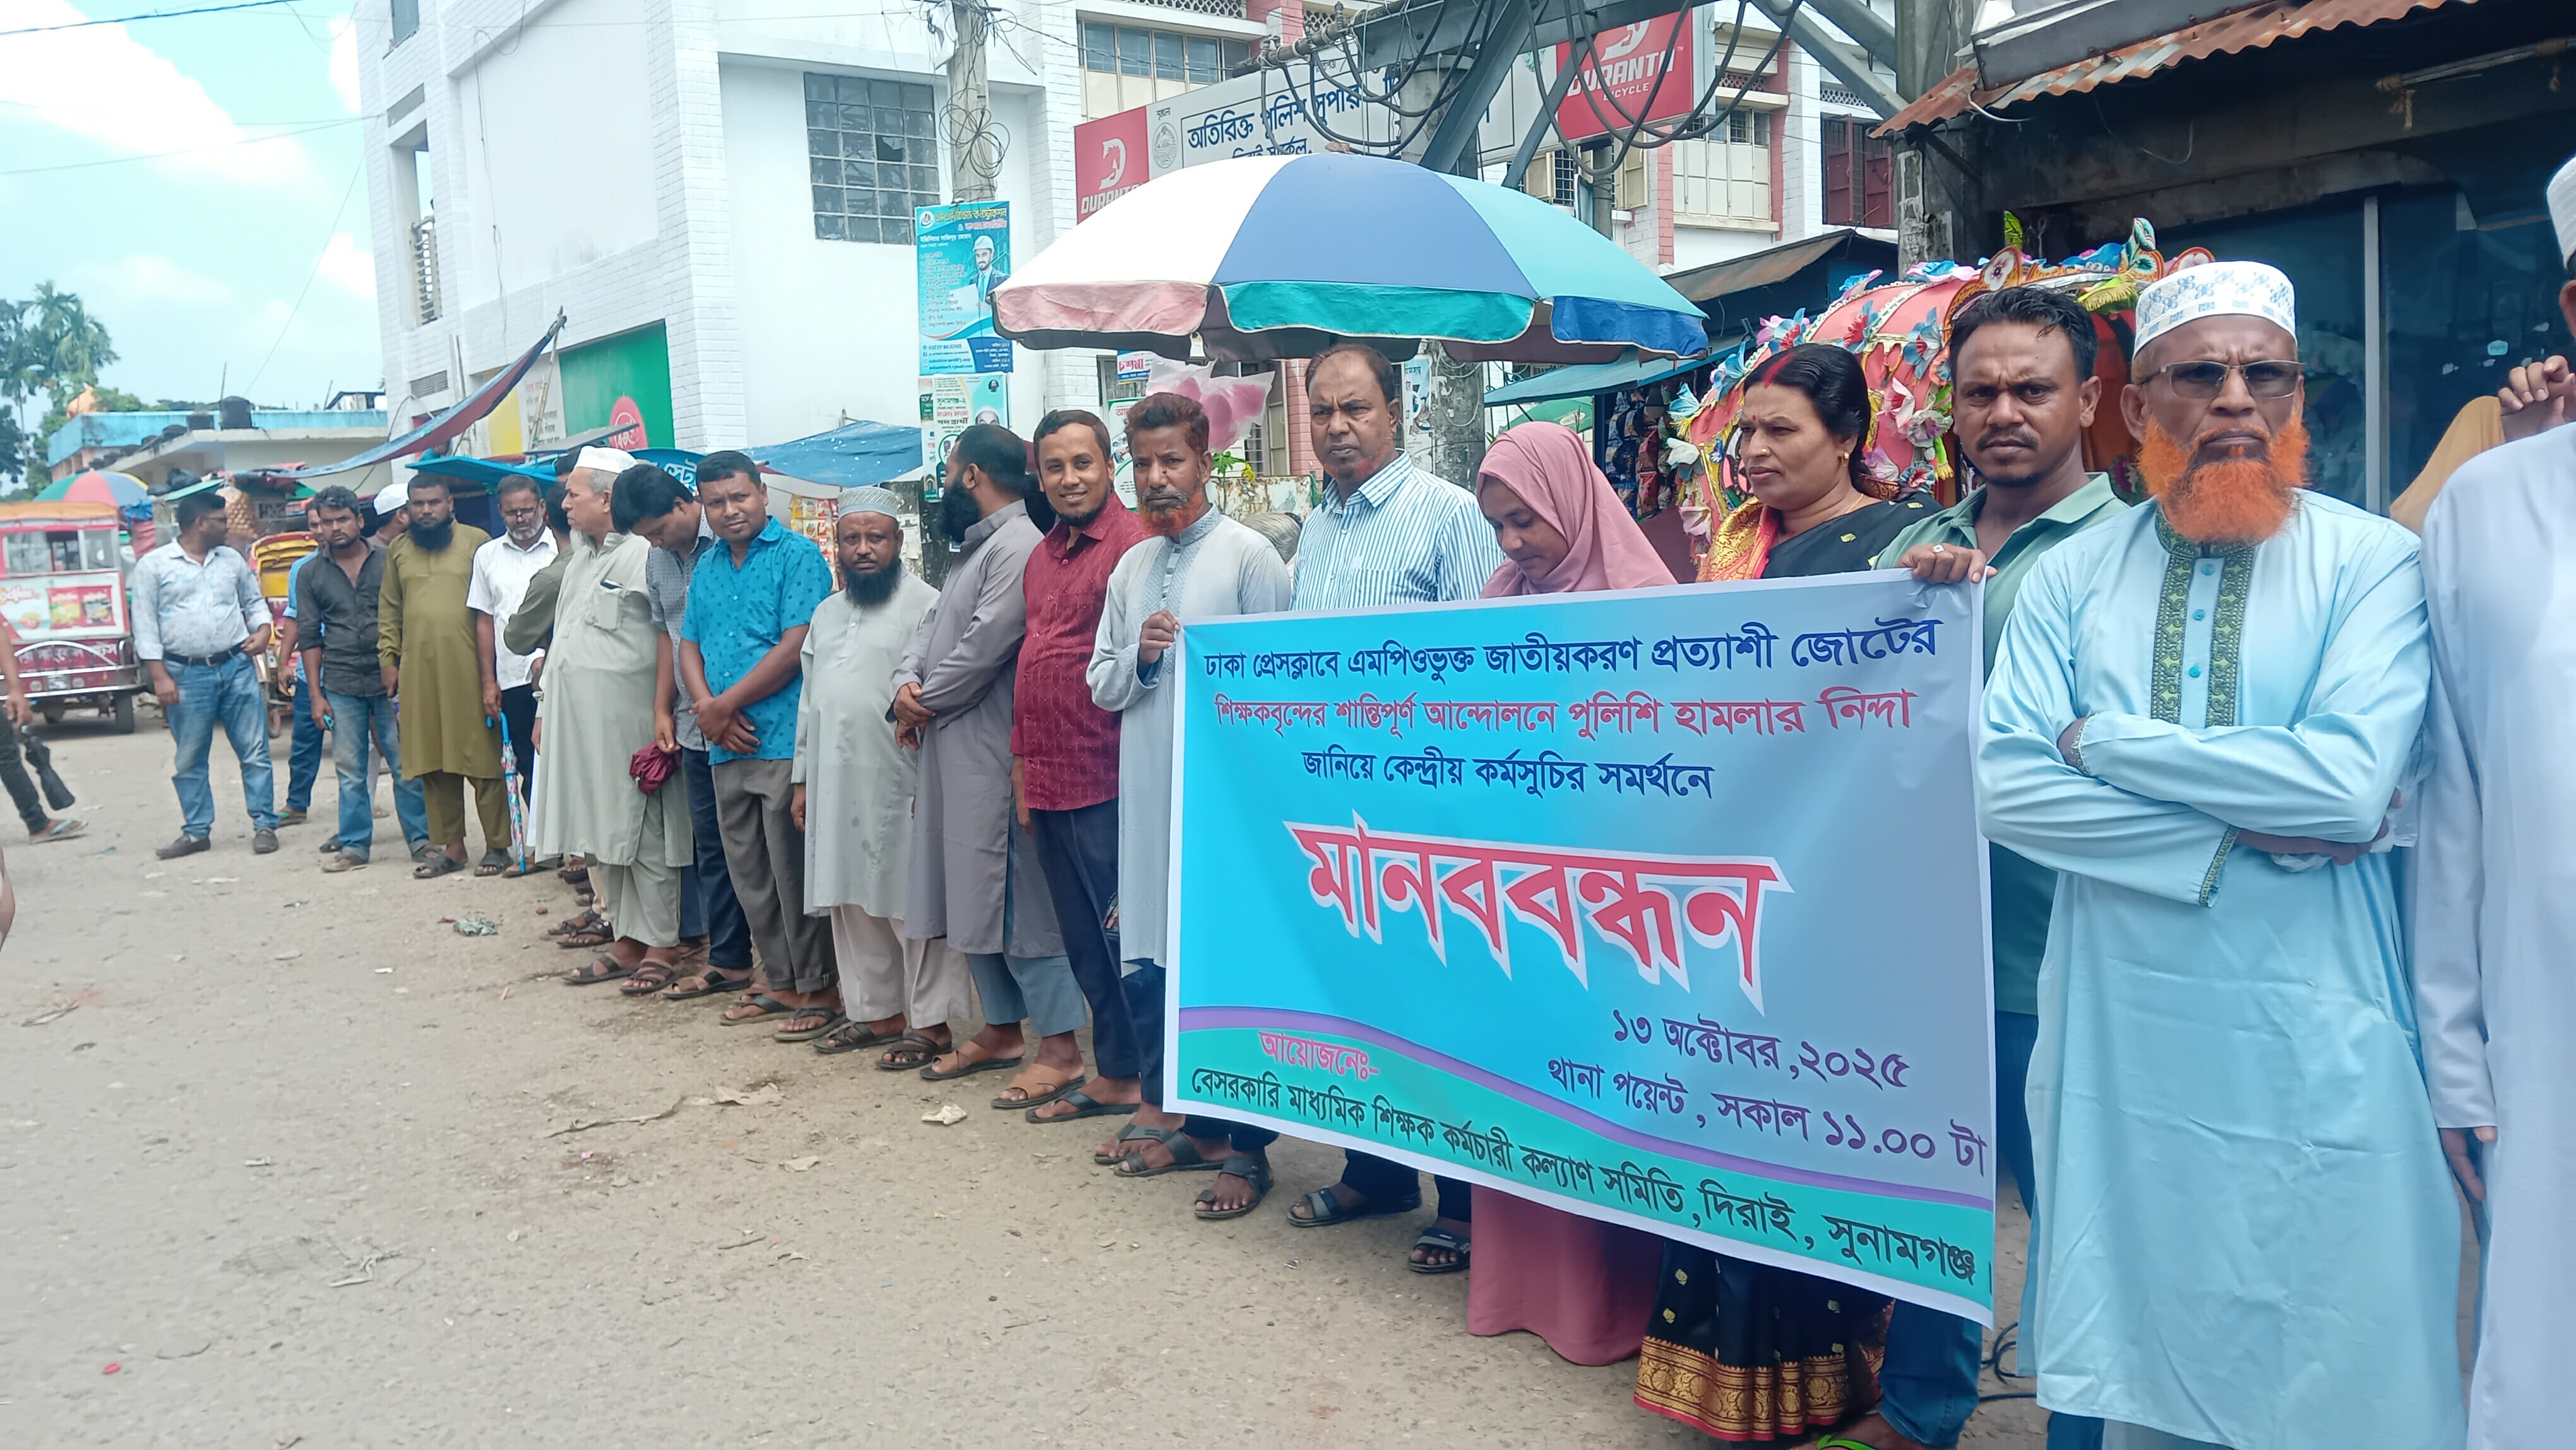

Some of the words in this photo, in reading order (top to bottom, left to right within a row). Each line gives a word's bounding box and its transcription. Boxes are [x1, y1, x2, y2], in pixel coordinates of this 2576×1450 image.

[1187, 110, 1255, 149] অতিরিক্ত
[1260, 95, 1308, 140] পুলিশ
[1315, 84, 1363, 126] সুপার
[1204, 651, 1246, 680] ঢাকা
[1253, 650, 1342, 682] প্রেসক্লাবে
[1348, 639, 1476, 685] এমপিওভুক্ত
[1482, 632, 1643, 674] জাতীয়করণ
[1651, 621, 1780, 673] প্রত্যাশী
[1791, 616, 1945, 667] জোটের
[1213, 692, 1328, 738] শিক্ষকবৃন্দের
[1335, 691, 1418, 740] শান্তিপূর্ণ
[1421, 700, 1559, 733] আন্দোলনে
[1568, 690, 1665, 742] পুলিশি
[1670, 697, 1808, 737] হামলার
[1815, 685, 1919, 731] নিন্দা
[1301, 743, 1378, 782] জানিয়ে
[1383, 745, 1466, 790] কেন্দ্রীয়
[1594, 752, 1716, 800] সমর্থনে
[1284, 811, 1793, 1014] মানববন্ধন
[1612, 1009, 1653, 1045] ১৩
[1661, 1012, 1782, 1072] অক্টোবর
[1547, 1055, 1606, 1100] থানা
[1611, 1071, 1689, 1118] পয়েন্ট
[1711, 1092, 1812, 1142] সকাল
[1823, 1110, 1936, 1159] ১১.০০
[1948, 1117, 1988, 1178] টা
[1191, 1067, 1283, 1110] বেসরকারি
[1286, 1083, 1367, 1129] মাধ্যমিক
[1371, 1094, 1436, 1147] শিক্ষক
[1438, 1119, 1515, 1173] কর্মচারী
[1518, 1142, 1596, 1195] কল্যাণ
[1597, 1159, 1687, 1214] সমিতি
[1820, 1213, 1976, 1287] সুনামগঞ্জ
